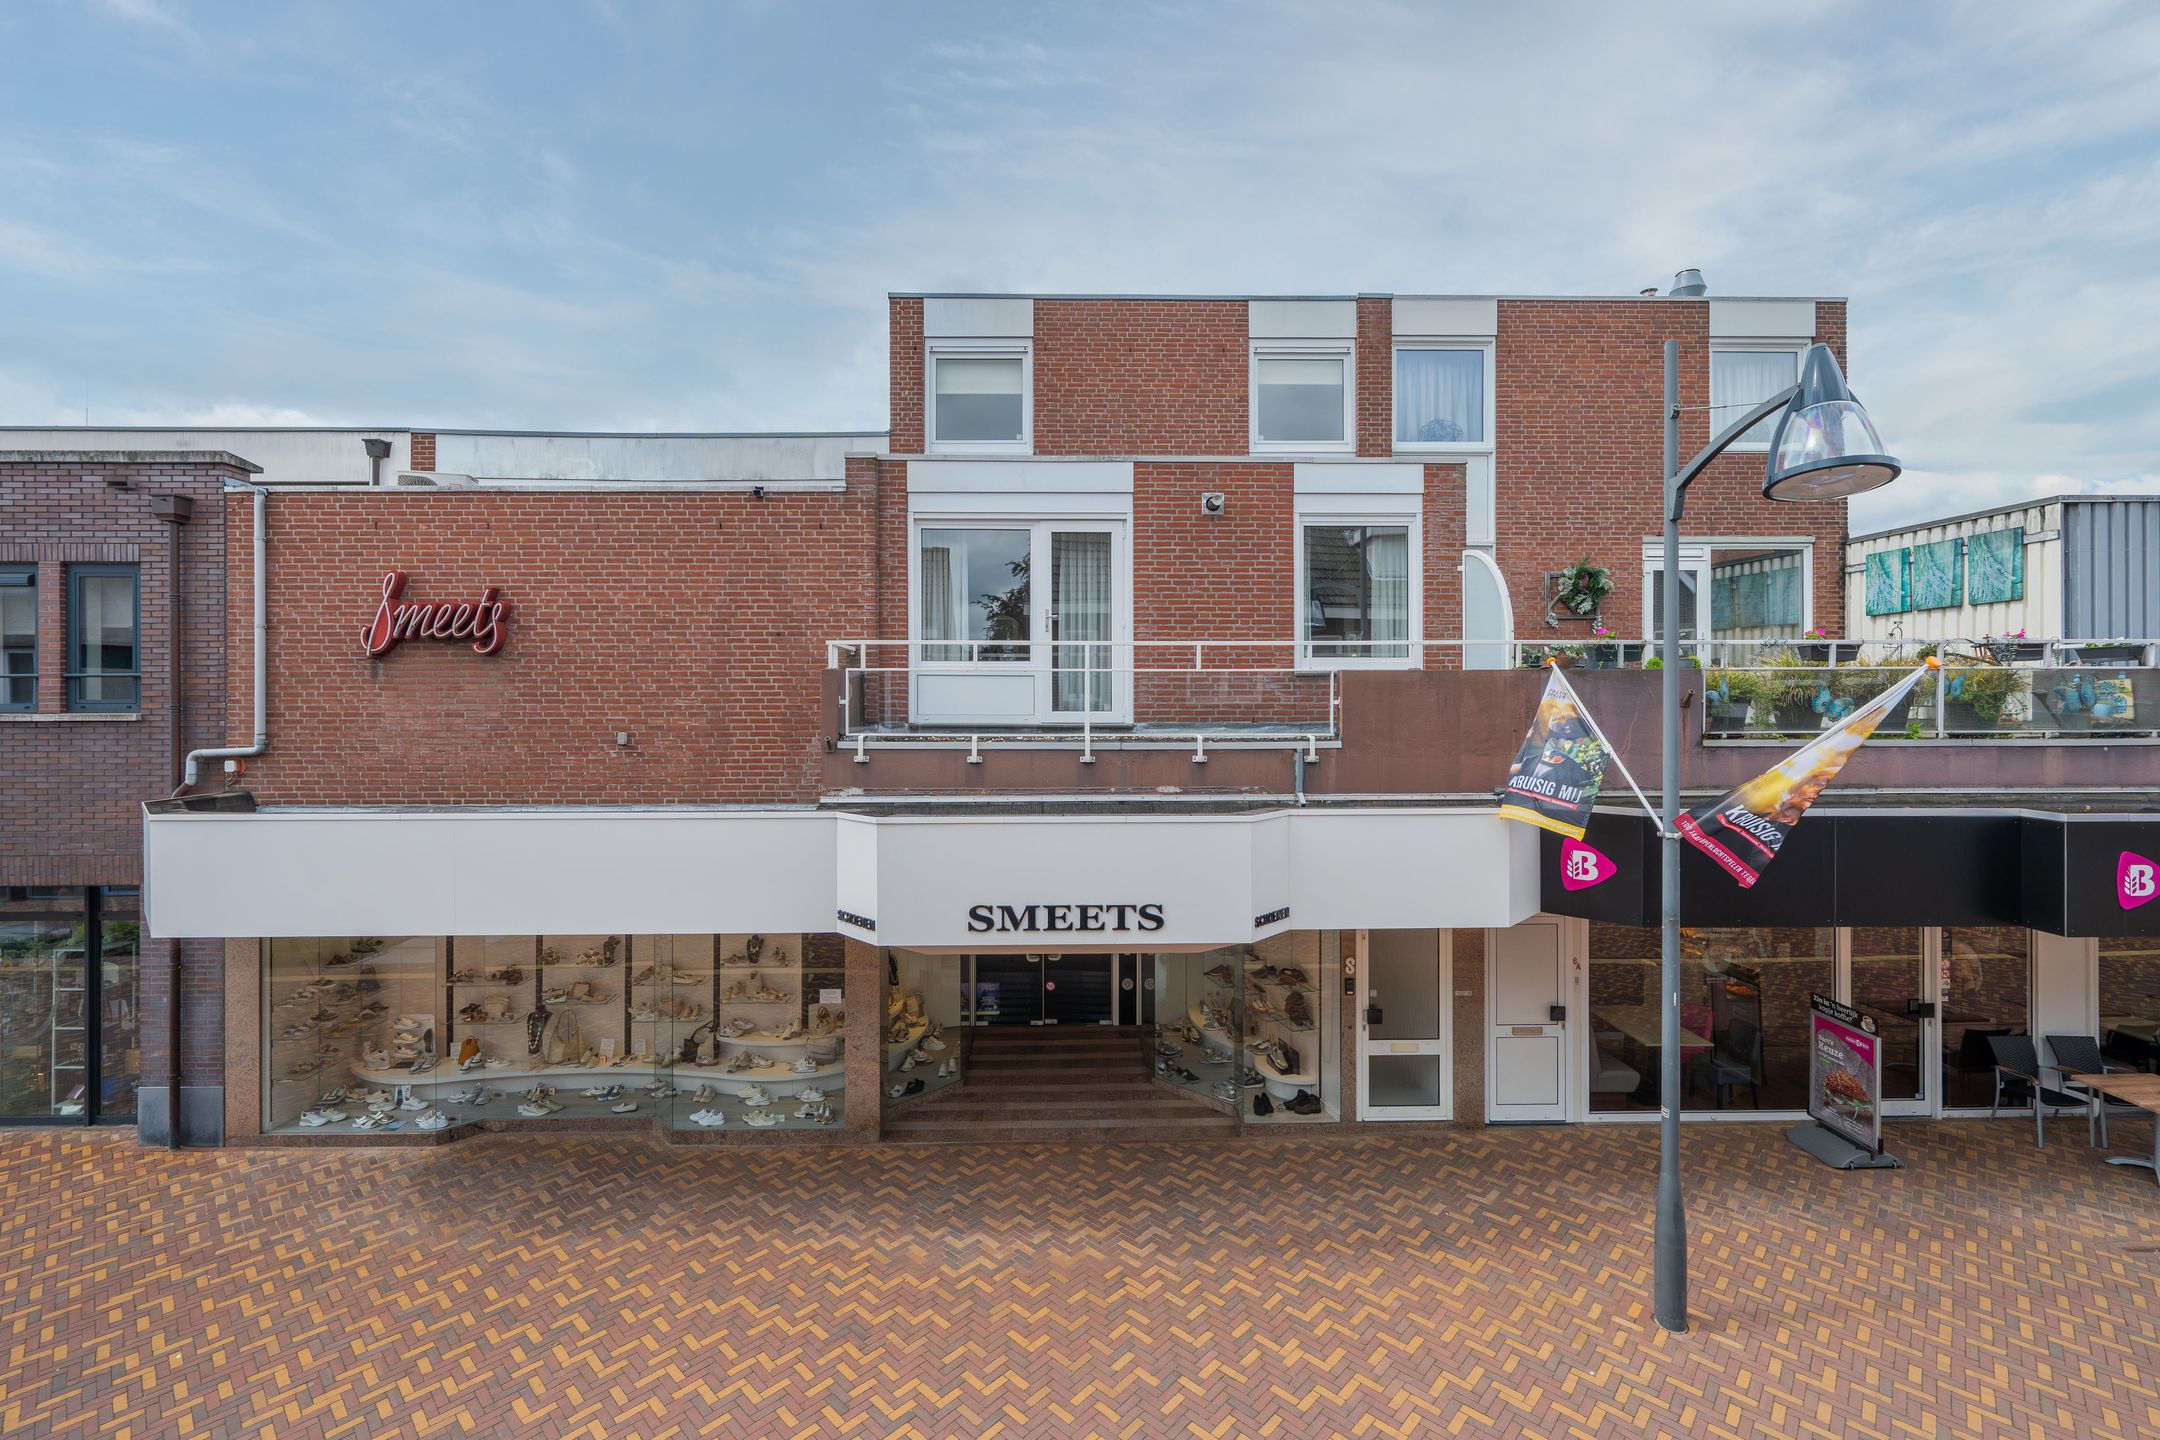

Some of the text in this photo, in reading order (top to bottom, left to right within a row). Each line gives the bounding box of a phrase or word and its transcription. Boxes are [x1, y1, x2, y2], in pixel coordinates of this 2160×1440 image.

[360, 570, 511, 656] Smeets
[1558, 784, 1583, 803] MIJ
[1681, 820, 1693, 831] 100
[967, 903, 1164, 932] SMEETS
[1818, 1041, 1844, 1059] Keuze
